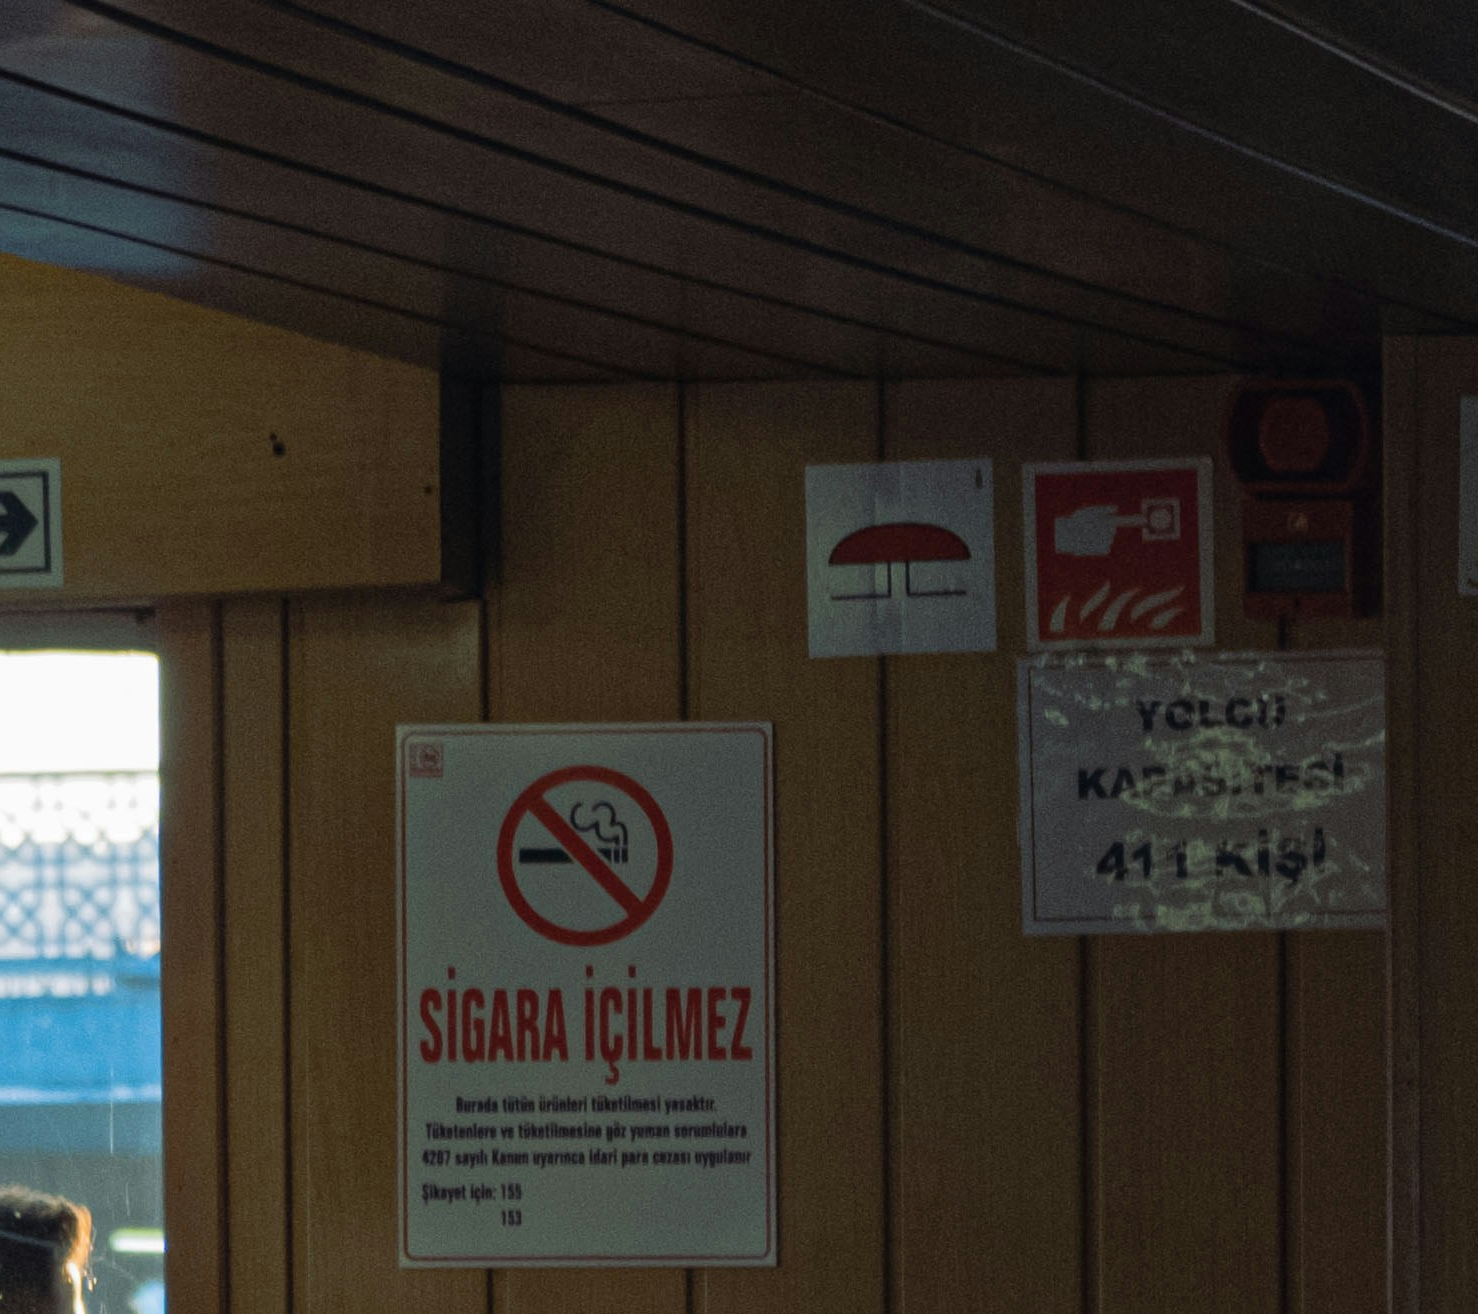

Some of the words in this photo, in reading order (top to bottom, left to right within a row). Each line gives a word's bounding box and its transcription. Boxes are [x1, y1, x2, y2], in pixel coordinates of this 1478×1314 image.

[1135, 694, 1288, 732] YOLCU
[1077, 752, 1347, 801] KAPASTESİ
[1096, 840, 1190, 882] 411
[1215, 826, 1327, 888] KİŞİ
[418, 966, 569, 1064] SİGARA
[584, 964, 754, 1087] İÇİLMEZ
[455, 1096, 498, 1114] Burada
[501, 1126, 515, 1140] ve
[606, 1121, 627, 1143] göz
[630, 1126, 671, 1142] yuman
[622, 1152, 650, 1168] para
[422, 1183, 467, 1206] Şikayet
[500, 1183, 523, 1200] 155
[501, 1208, 523, 1227] 153
